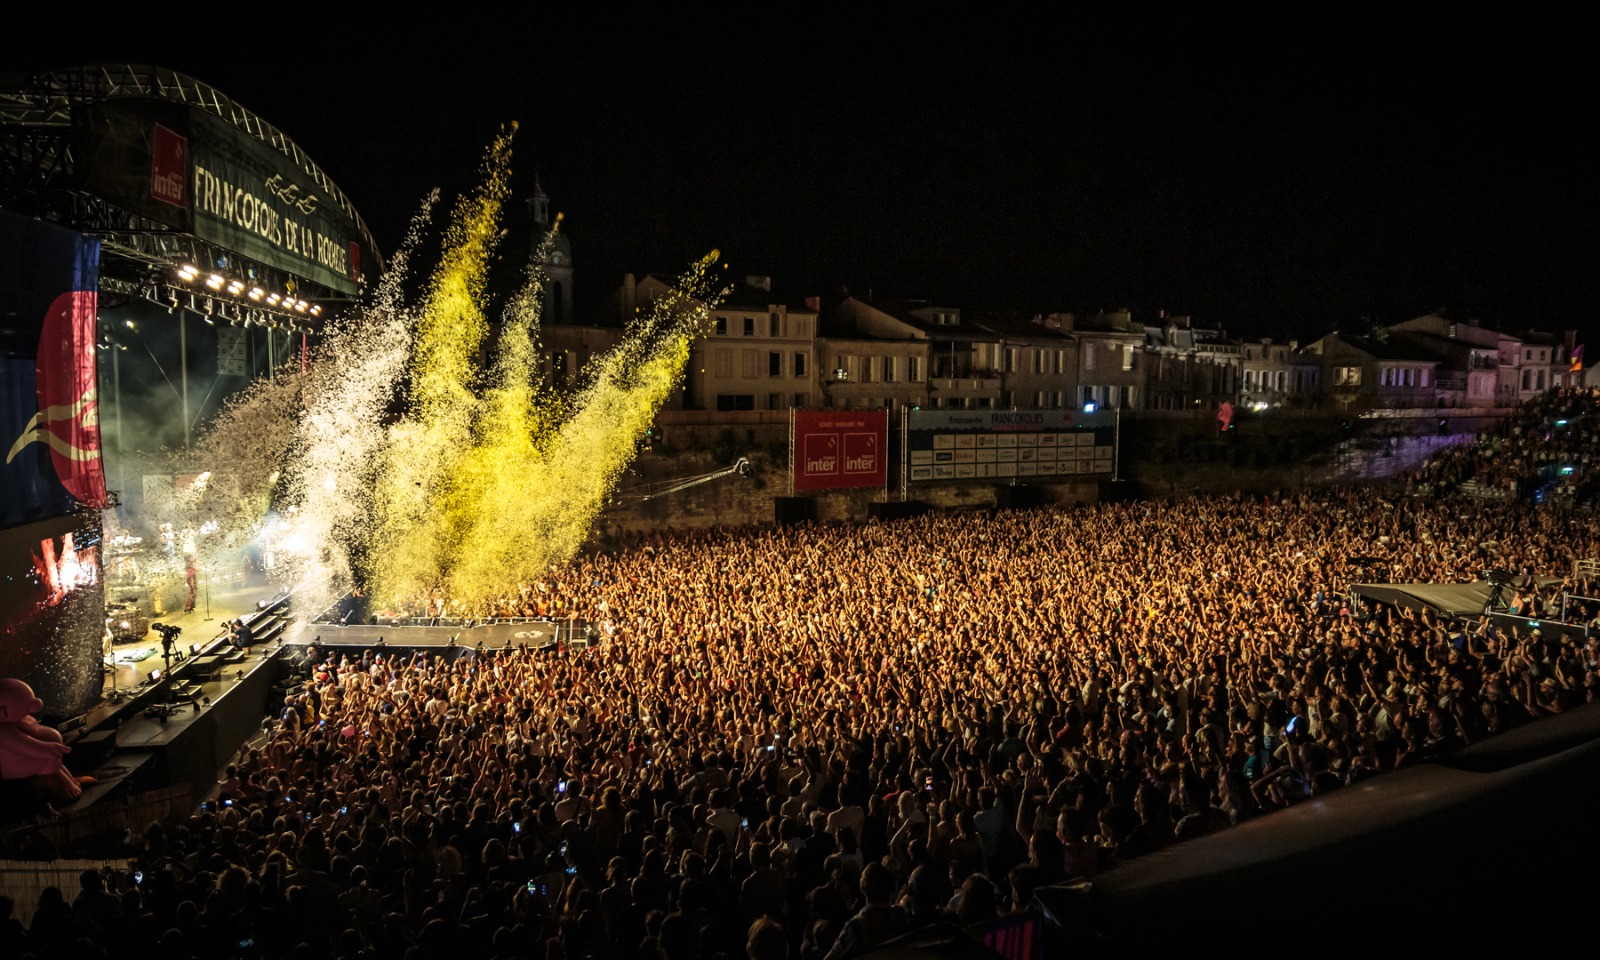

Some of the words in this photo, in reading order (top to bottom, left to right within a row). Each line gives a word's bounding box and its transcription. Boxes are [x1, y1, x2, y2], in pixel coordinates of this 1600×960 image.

[154, 167, 184, 200] inter
[284, 218, 299, 253] DE
[301, 226, 314, 259] LA
[991, 413, 1044, 424] FRANCOFOLIES
[807, 457, 836, 472] inter
[846, 456, 874, 470] inter
